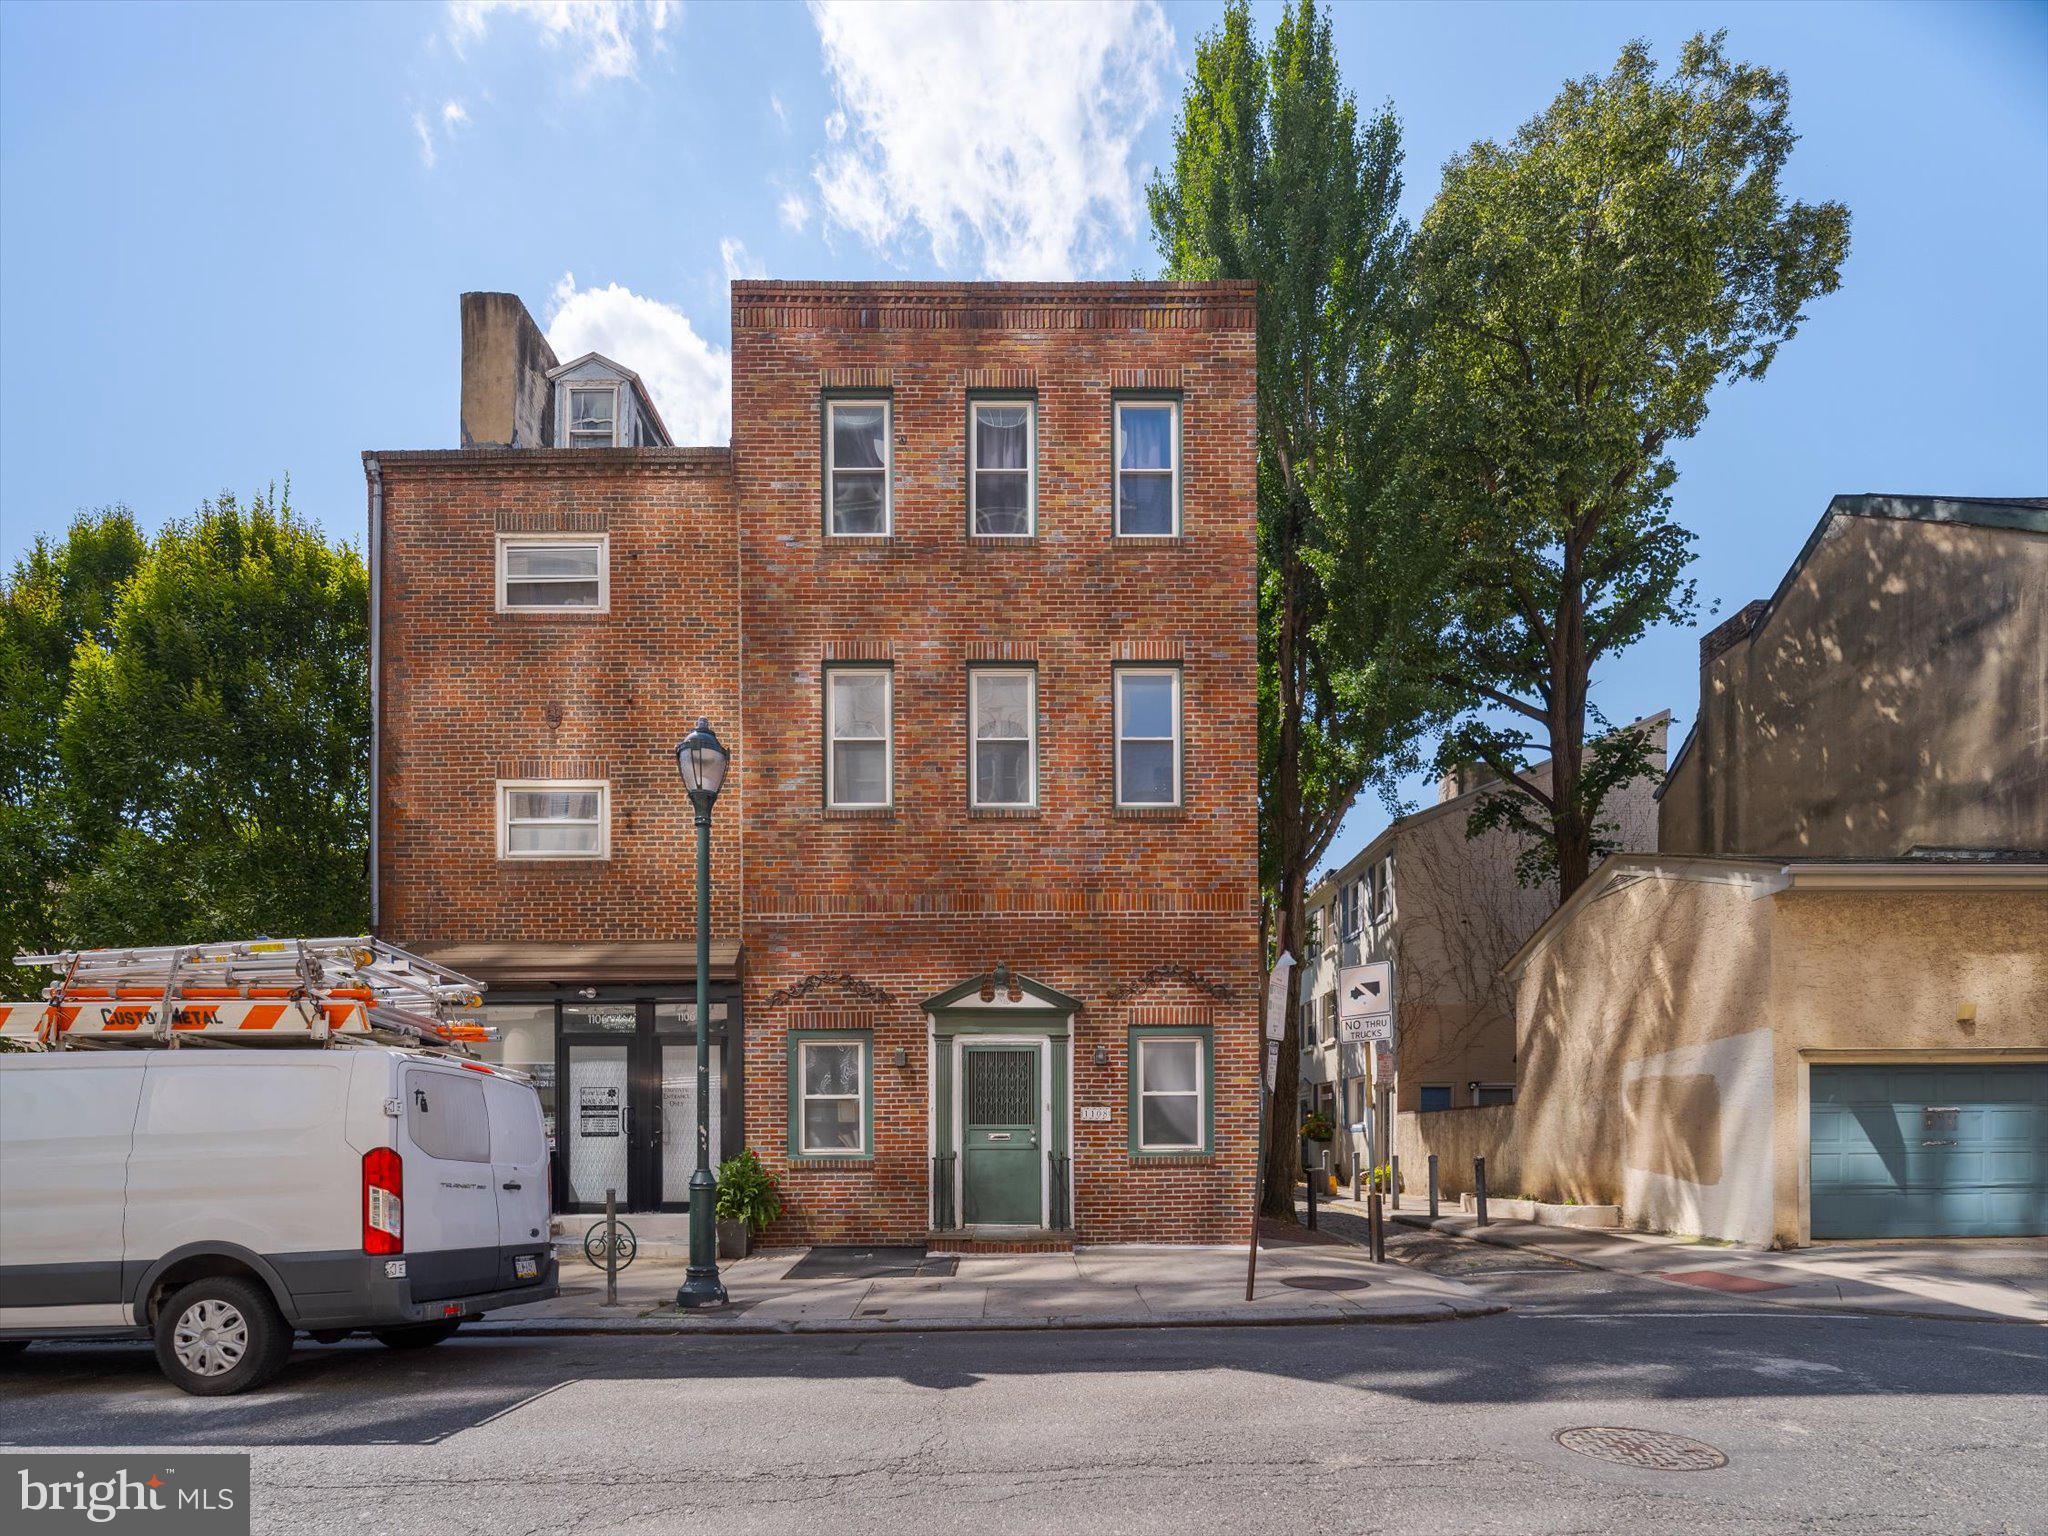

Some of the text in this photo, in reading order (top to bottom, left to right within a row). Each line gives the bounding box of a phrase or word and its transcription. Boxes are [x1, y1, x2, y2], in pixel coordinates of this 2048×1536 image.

[100, 1007, 158, 1026] CUSTO
[587, 1013, 608, 1024] 1106
[1345, 1019, 1387, 1030] NO THRU
[1350, 1029, 1382, 1039] TRUCKS
[1085, 1110, 1109, 1118] 1108
